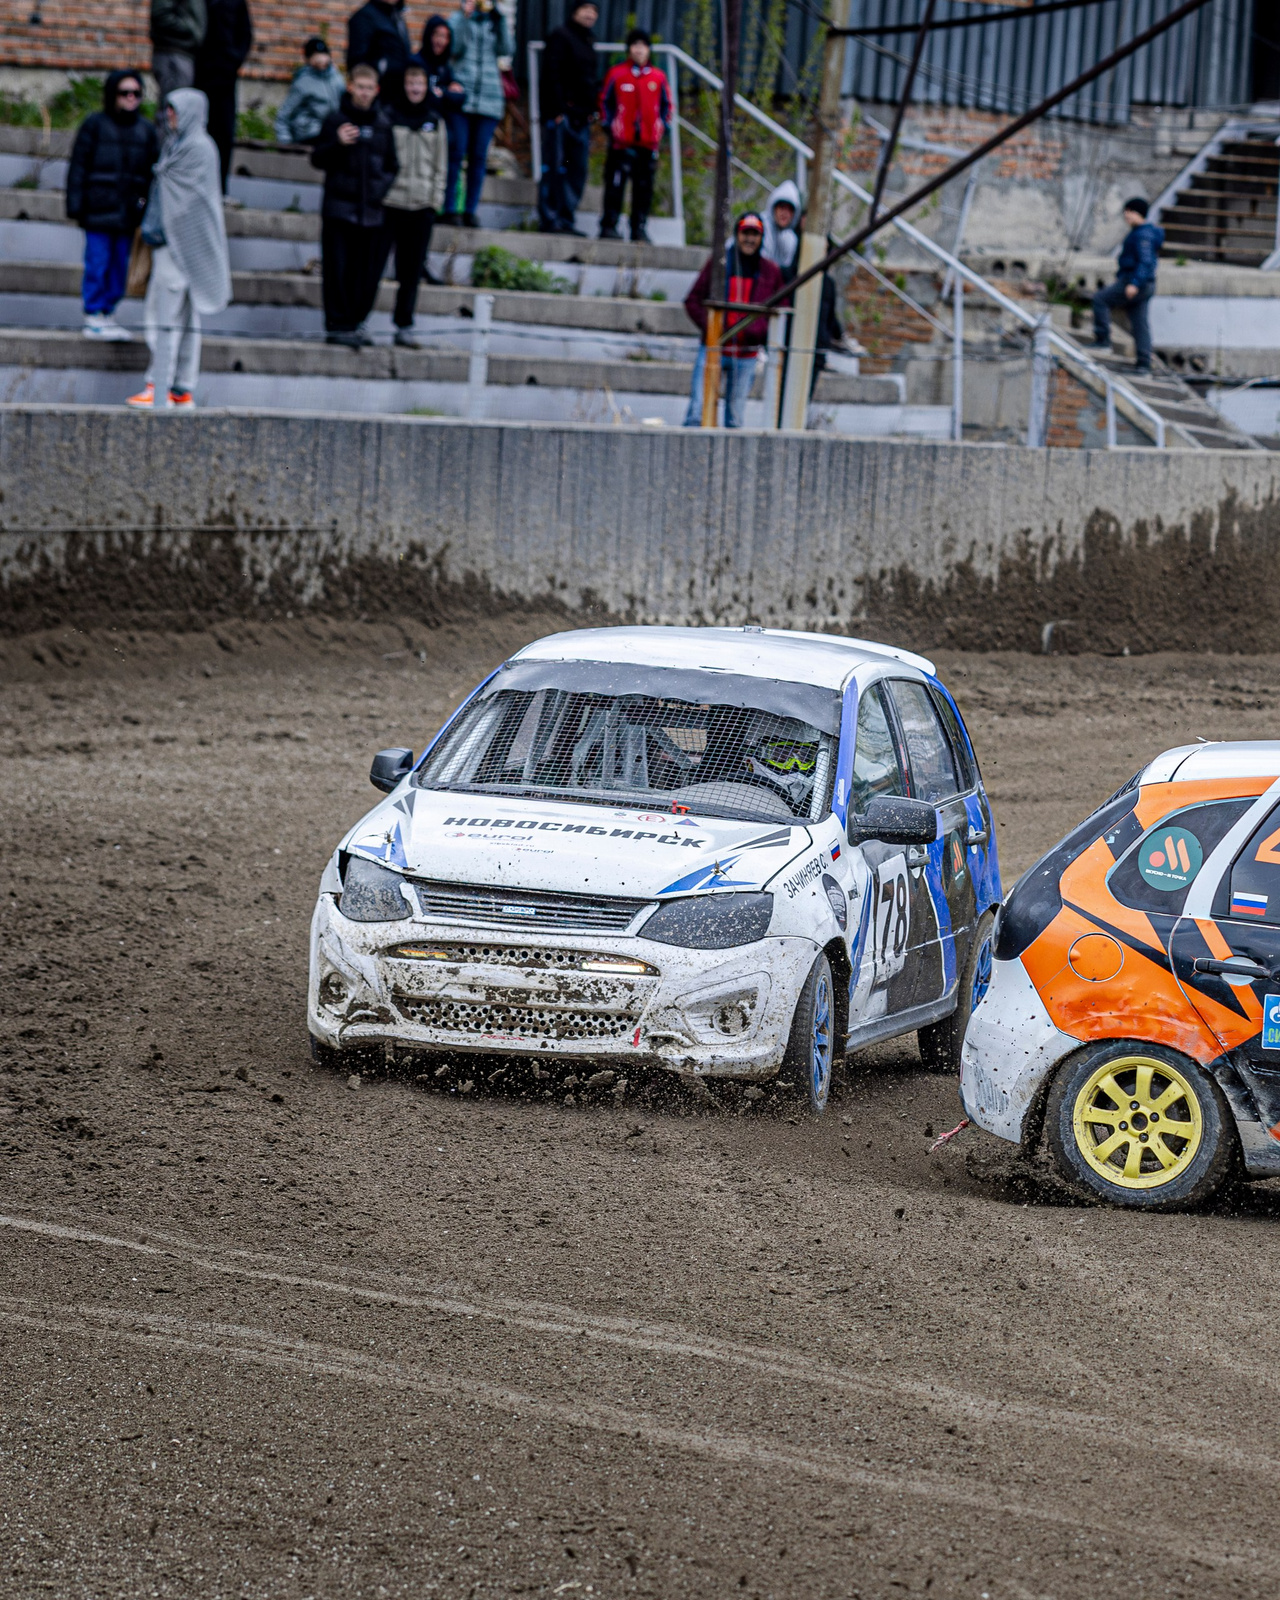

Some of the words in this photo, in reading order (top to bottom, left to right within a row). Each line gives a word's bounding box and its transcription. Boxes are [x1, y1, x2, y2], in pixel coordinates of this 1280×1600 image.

[443, 817, 706, 848] НОВОСИБИРСК
[467, 833, 533, 841] eurol
[783, 858, 822, 899] ЗАЧИНЯЕВ
[880, 873, 907, 964] 78
